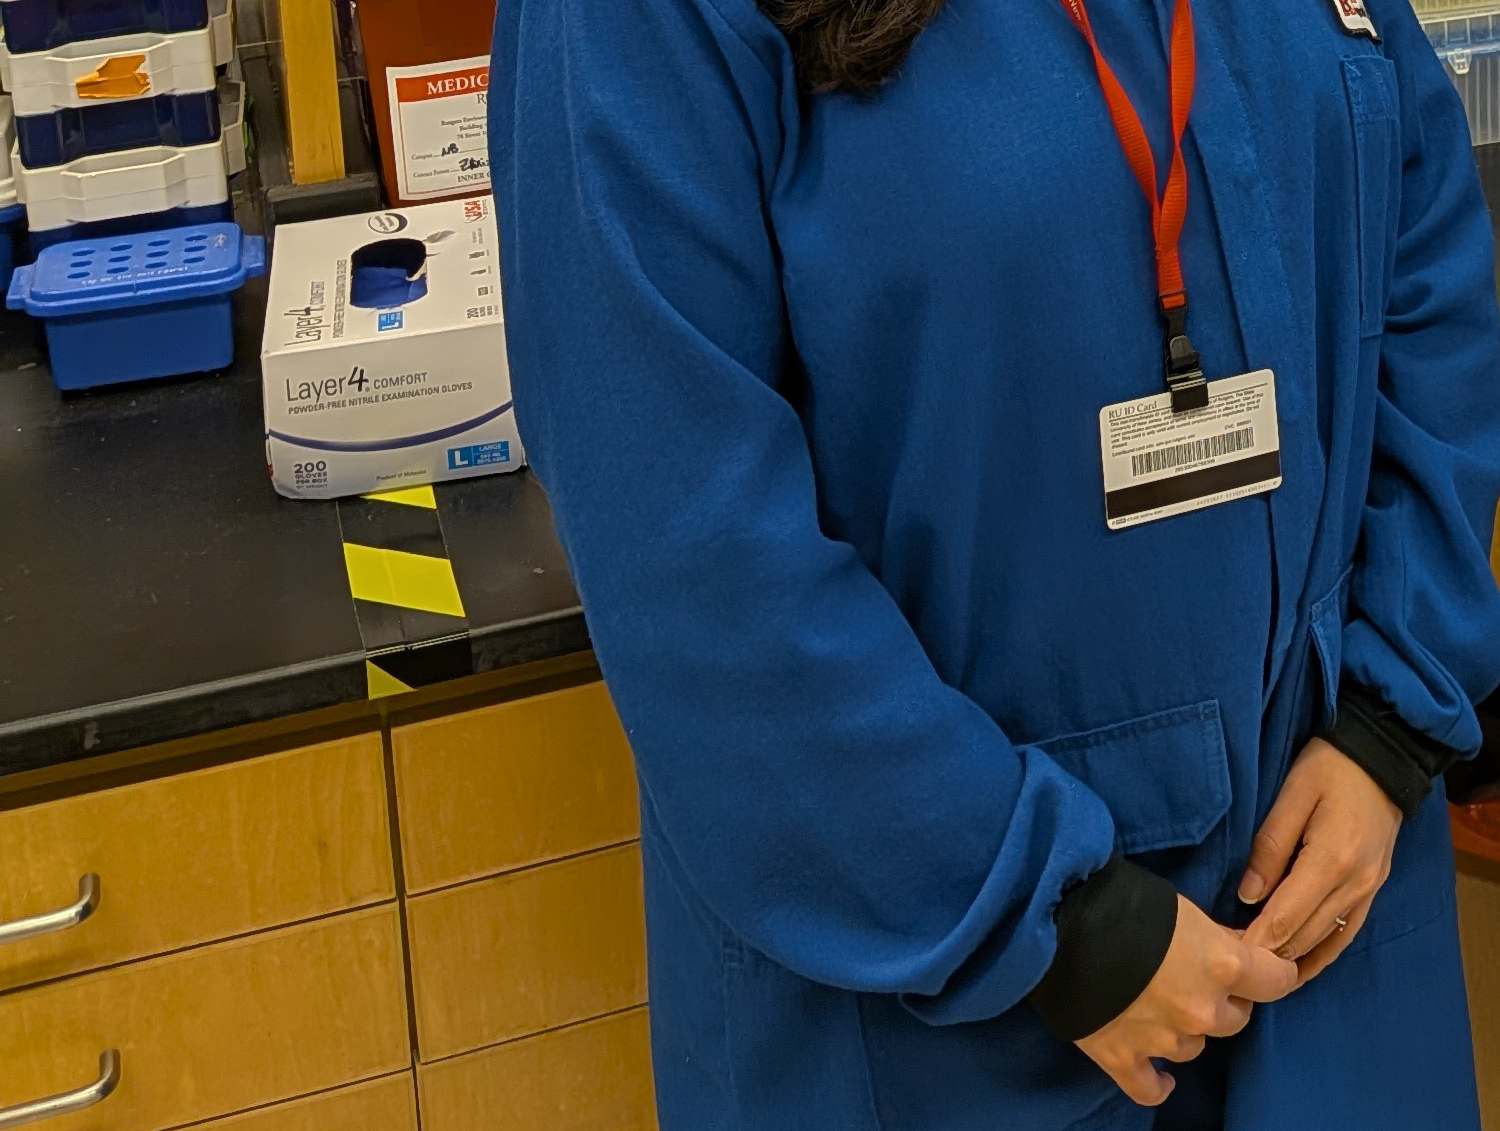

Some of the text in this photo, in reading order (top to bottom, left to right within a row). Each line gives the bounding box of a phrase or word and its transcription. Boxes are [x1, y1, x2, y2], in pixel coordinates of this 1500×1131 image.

[373, 371, 428, 390] COMFORT
[288, 381, 473, 415] POWDER-FREE NITRILE EXAMINATION GLOVES
[1136, 401, 1158, 413] Card
[454, 450, 468, 466] L
[293, 460, 327, 473] 200
